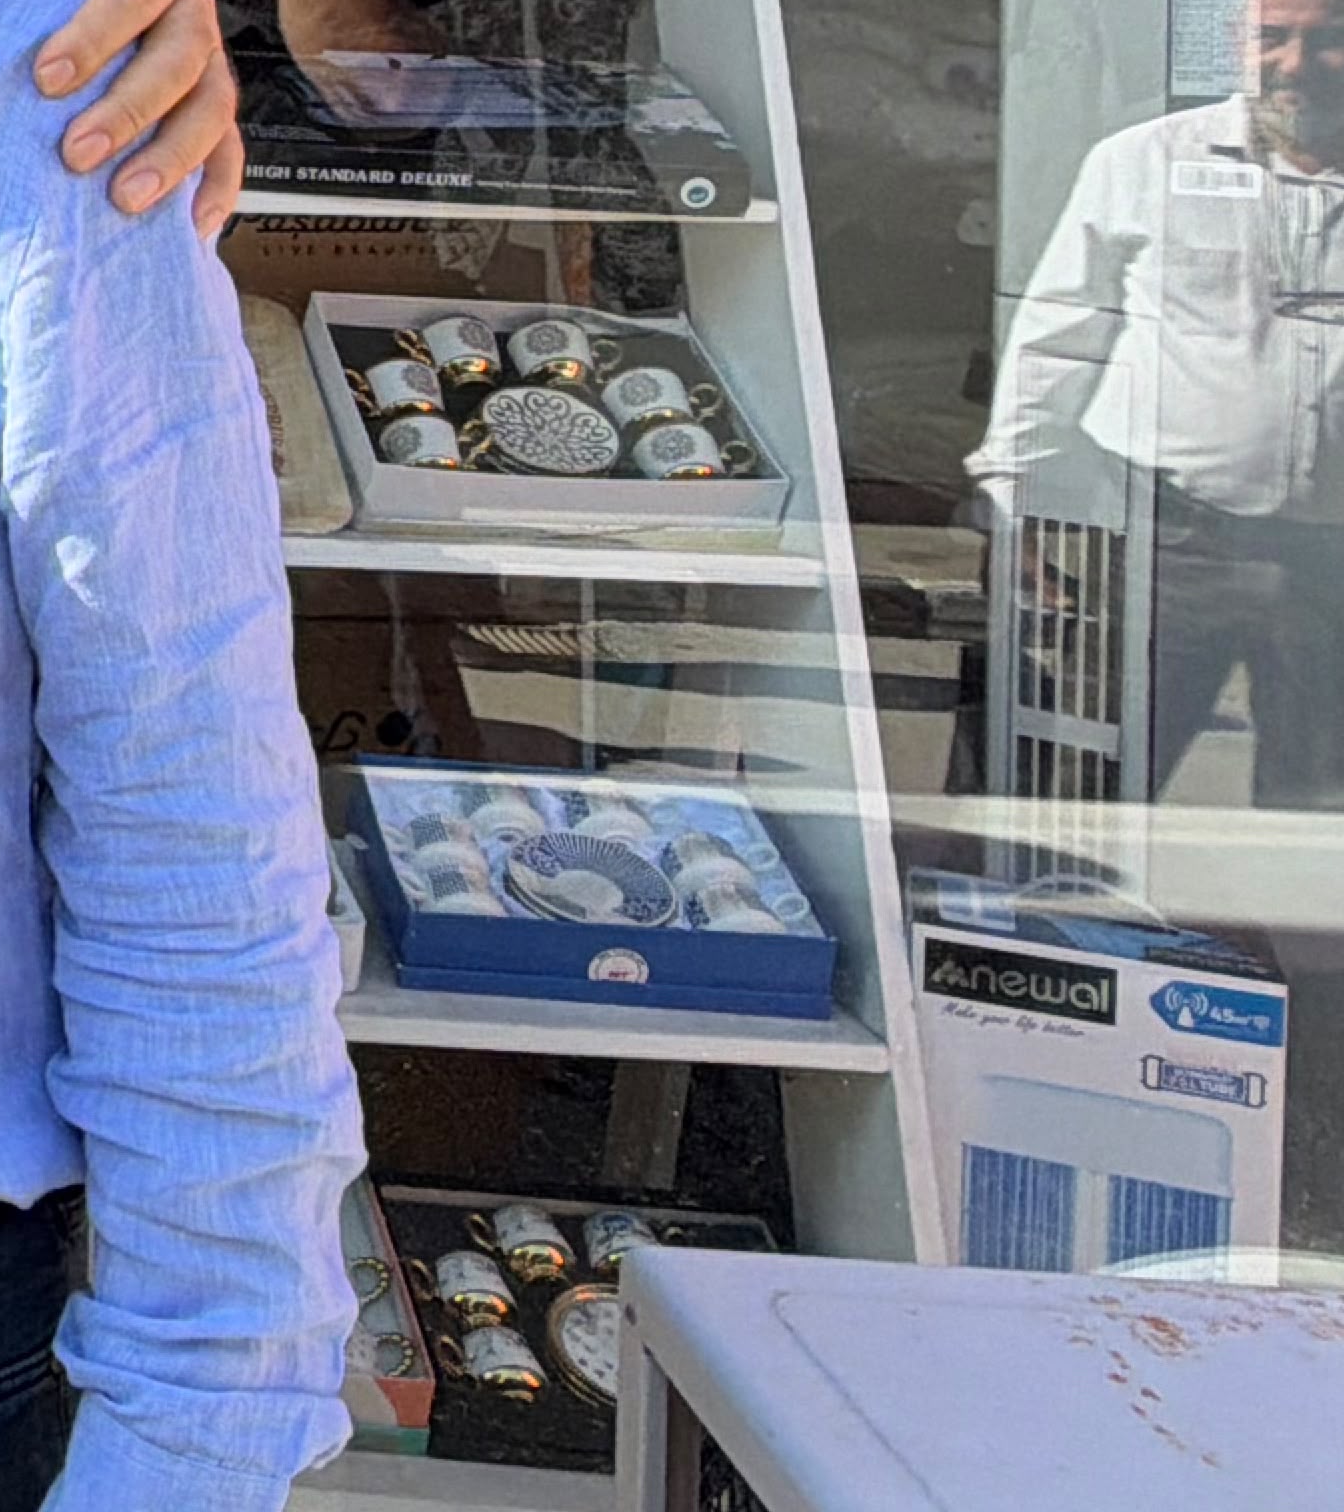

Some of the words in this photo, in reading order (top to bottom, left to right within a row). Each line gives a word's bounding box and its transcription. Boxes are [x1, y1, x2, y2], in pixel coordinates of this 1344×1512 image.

[246, 164, 291, 180] HIGH
[296, 165, 394, 185] STANDARD
[401, 170, 472, 187] DELUXE
[971, 964, 1110, 1014] newal
